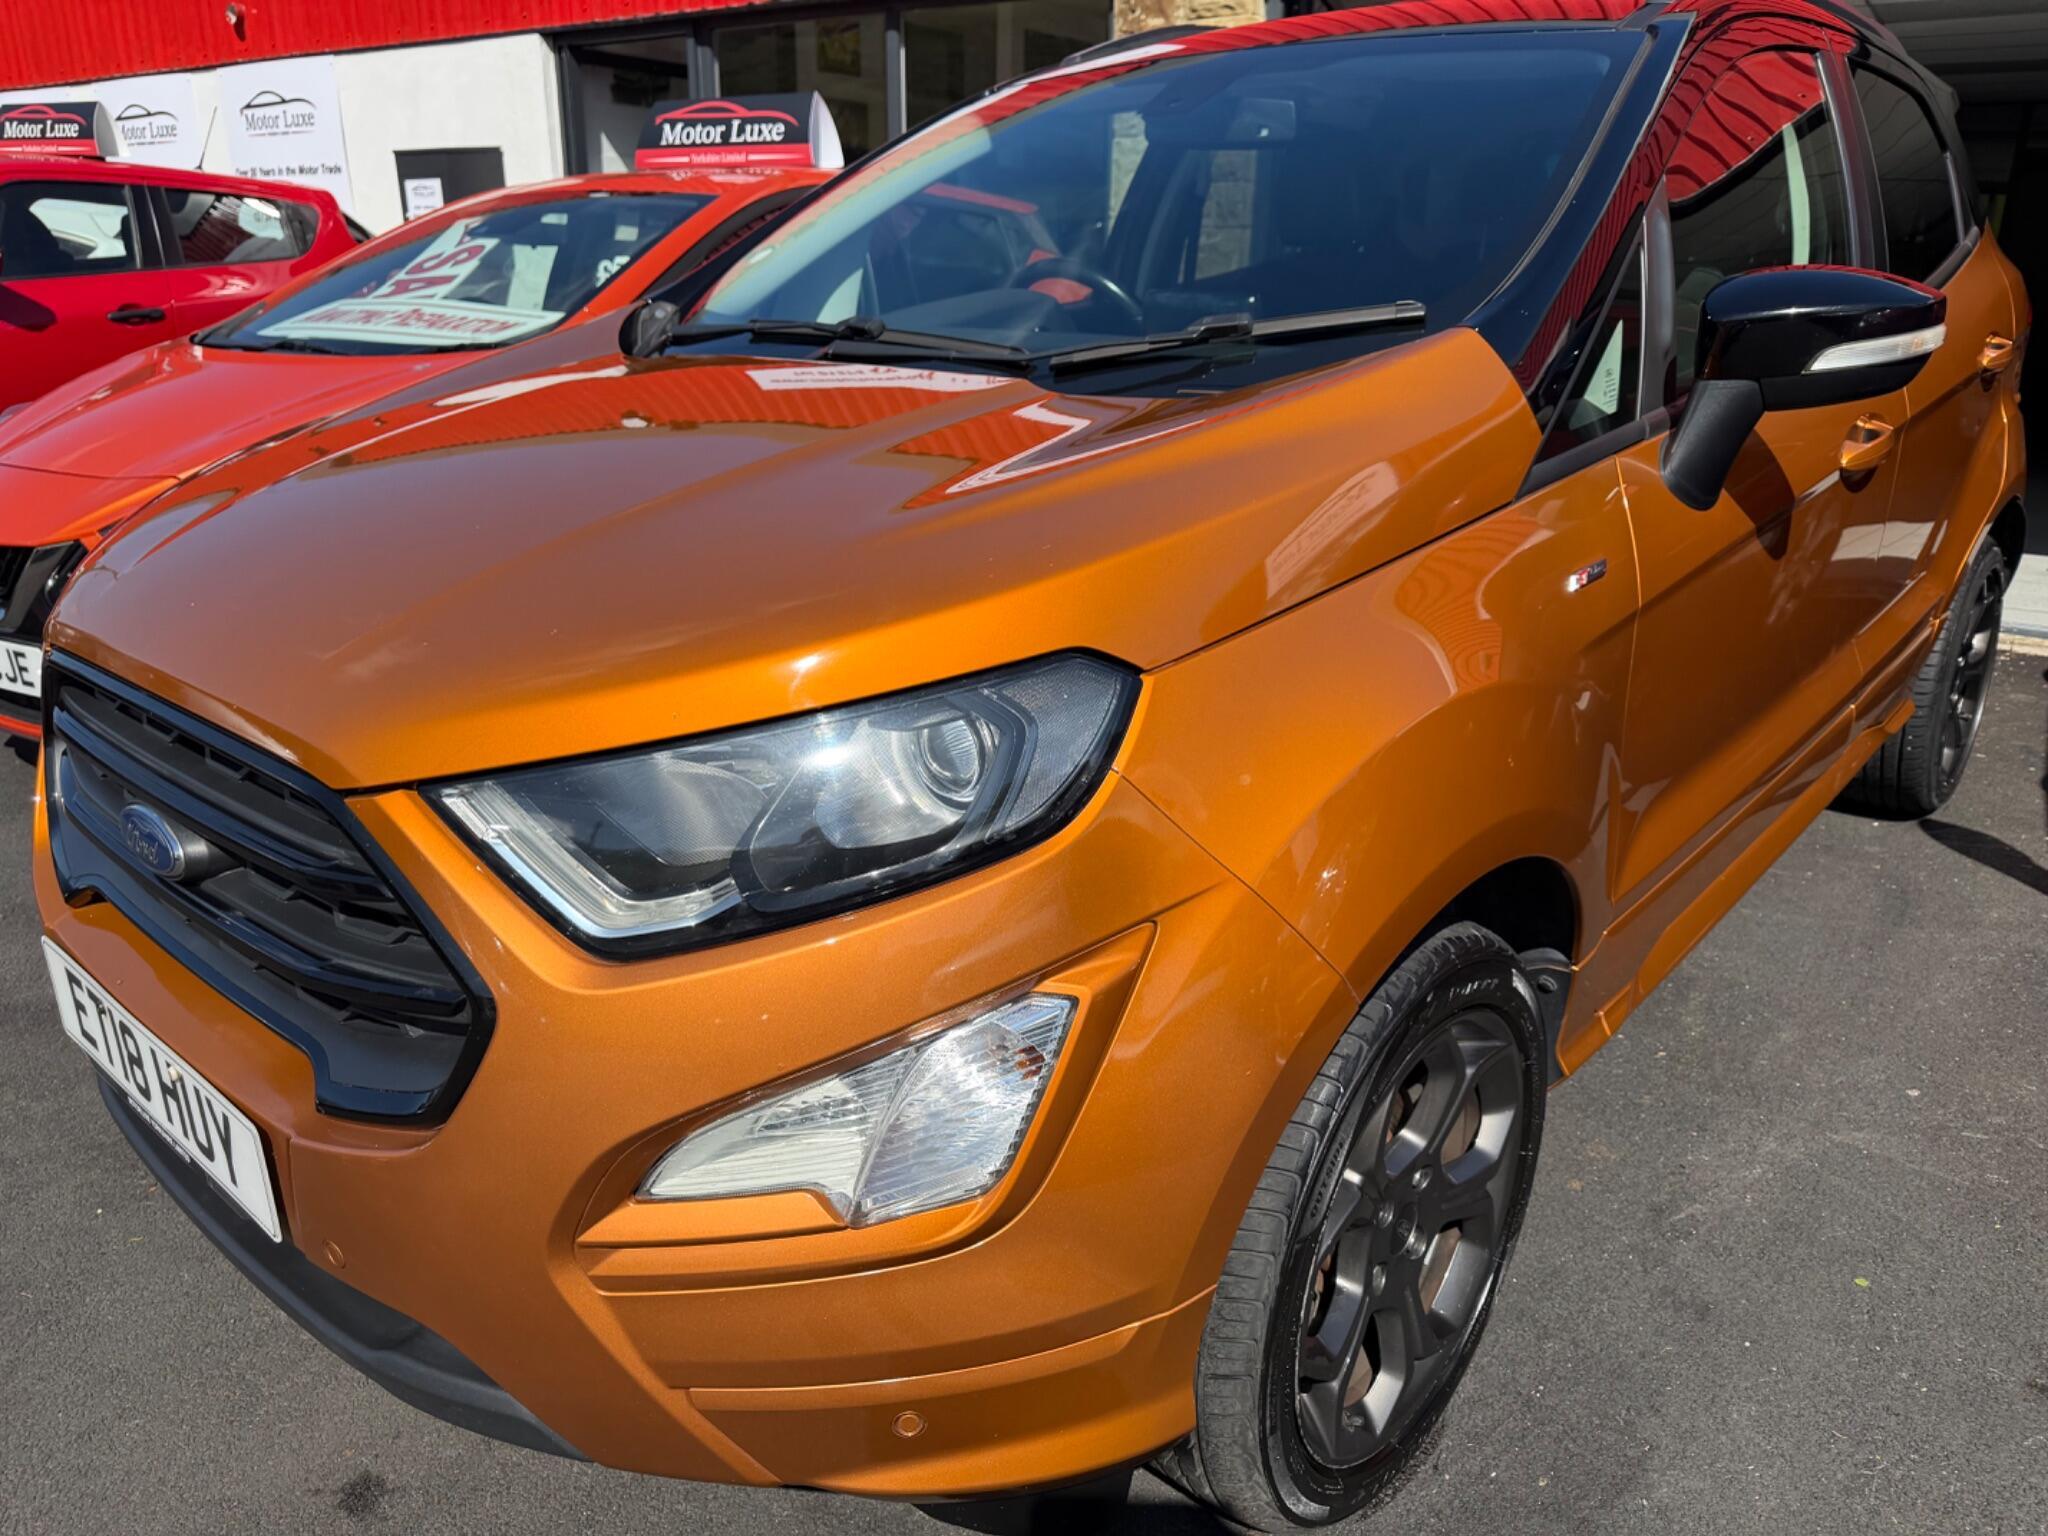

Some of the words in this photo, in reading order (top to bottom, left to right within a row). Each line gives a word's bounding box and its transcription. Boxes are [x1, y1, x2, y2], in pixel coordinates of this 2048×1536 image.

[3, 120, 43, 139] Motor
[45, 119, 80, 138] Luxe
[148, 121, 178, 139] Luxe
[245, 112, 279, 131] Motor
[282, 109, 315, 128] Luxe
[660, 121, 726, 146] Motor
[729, 118, 785, 144] Luxe
[298, 164, 319, 176] Motor
[0, 648, 36, 688] JE
[64, 966, 152, 1102] ET18
[150, 1045, 239, 1188] HUY
